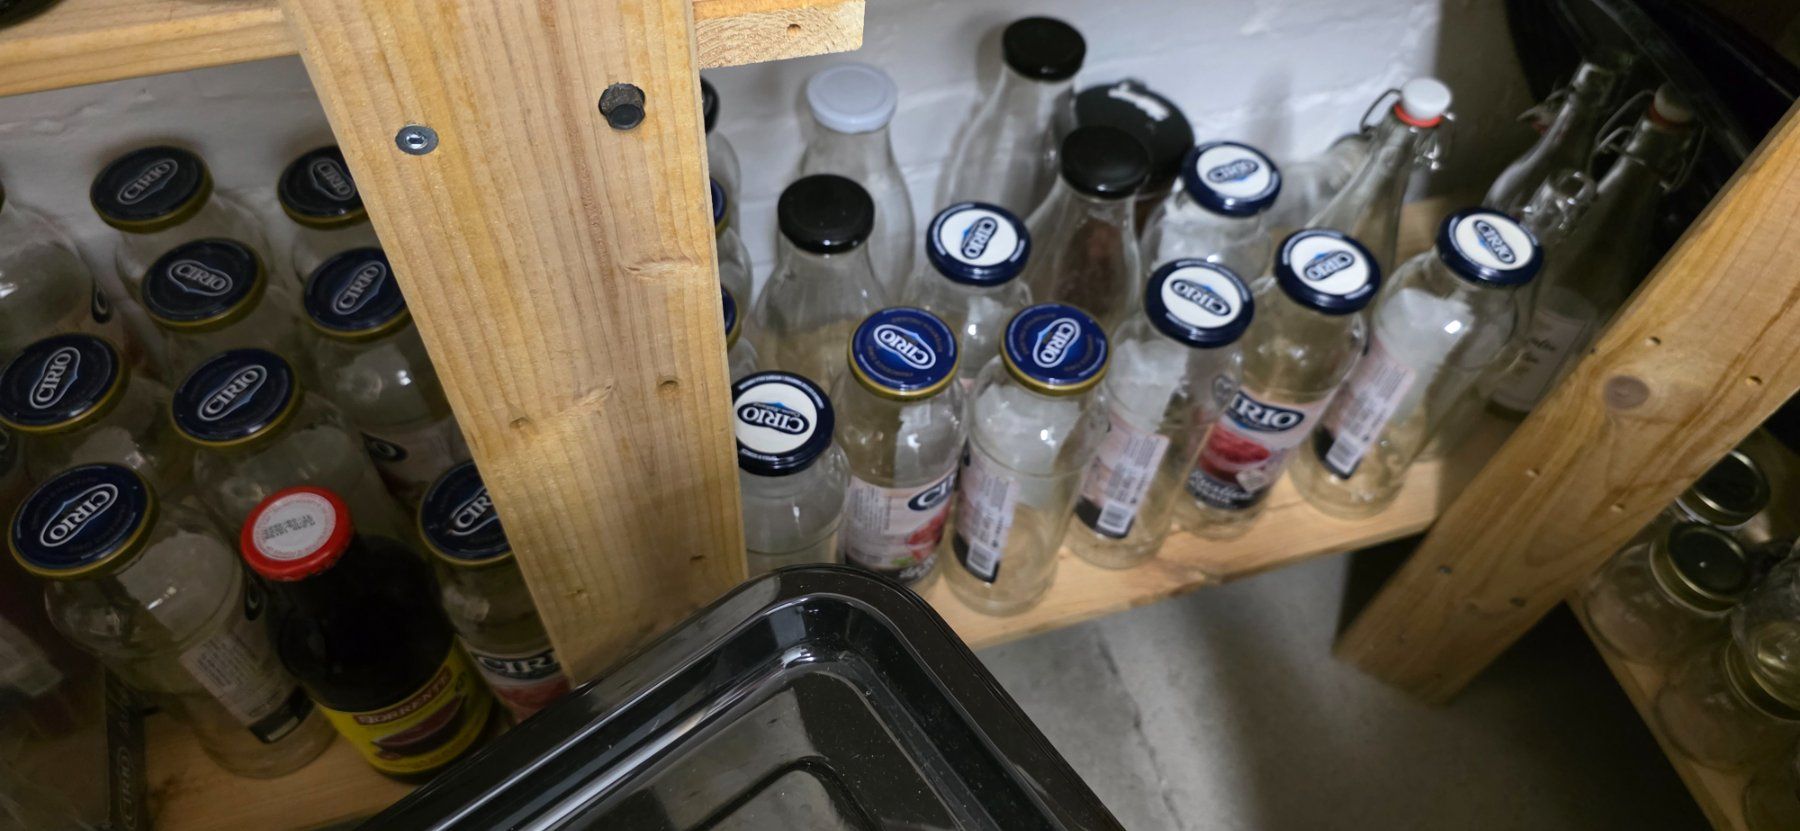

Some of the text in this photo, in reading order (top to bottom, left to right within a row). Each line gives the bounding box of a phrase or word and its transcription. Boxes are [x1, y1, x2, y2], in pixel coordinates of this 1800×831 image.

[123, 163, 170, 200] CIRIO
[317, 162, 350, 196] CIRIO
[1209, 160, 1257, 182] CIRIO
[965, 218, 996, 257] CIRIO
[1476, 222, 1513, 262] CIRIO
[176, 262, 226, 291] CIRIO
[1306, 252, 1352, 280] CIRIO
[336, 264, 380, 309] CIRIO
[1175, 282, 1228, 313] CIRIO
[881, 329, 929, 366] CIRIO
[1041, 323, 1077, 364] CIRIO
[36, 353, 71, 402] CIRIO
[206, 370, 258, 414] CIRIO
[742, 406, 805, 433] CIRIO
[50, 490, 110, 540] CIRIO
[456, 493, 492, 528] CIR
[478, 656, 548, 674] CIR
